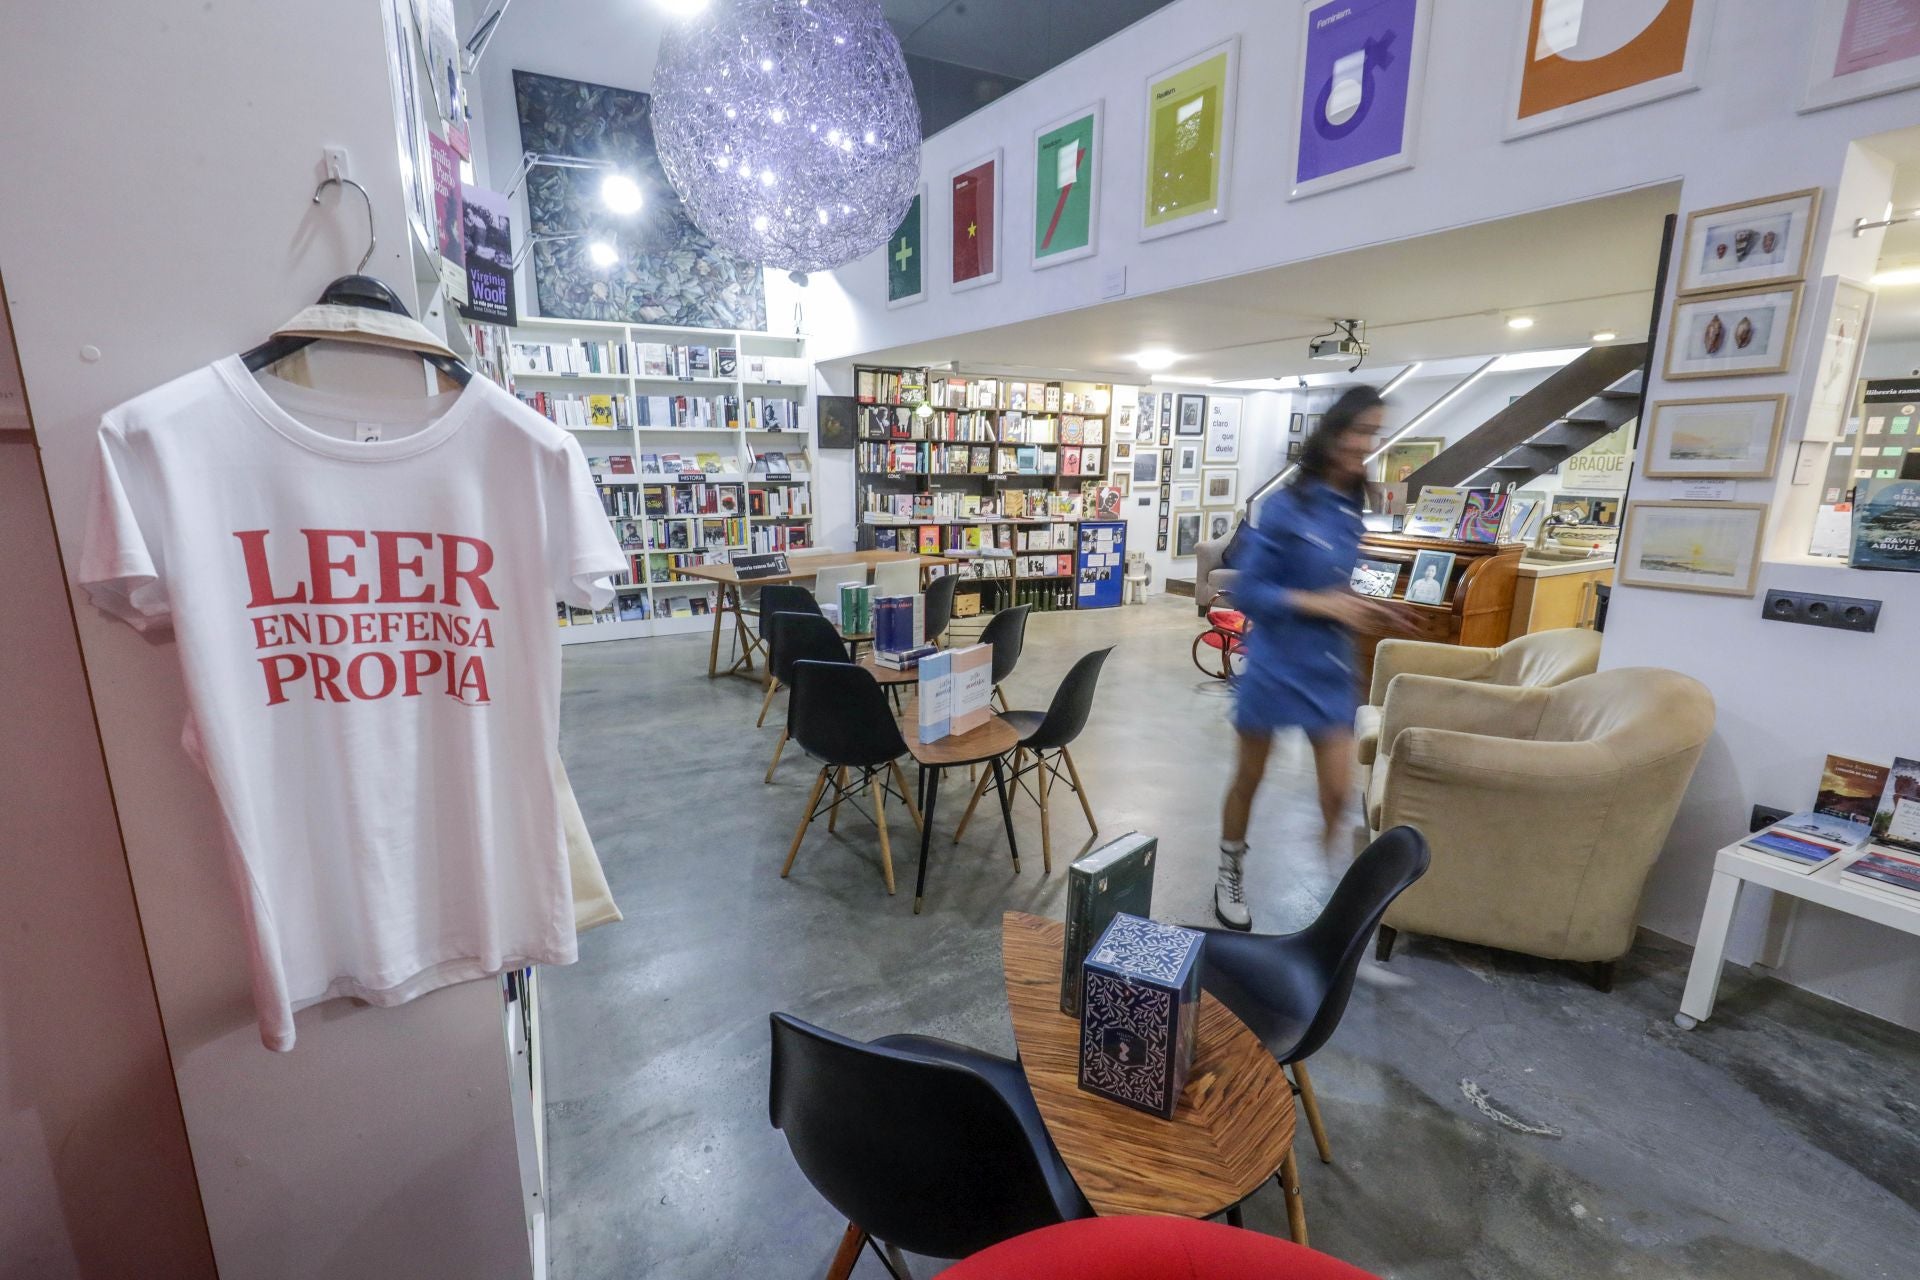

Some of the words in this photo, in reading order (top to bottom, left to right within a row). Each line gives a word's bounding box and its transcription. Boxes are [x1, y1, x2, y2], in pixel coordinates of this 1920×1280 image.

[470, 268, 506, 286] Virginia
[471, 280, 507, 305] Woolf
[1221, 433, 1234, 441] que
[1215, 443, 1234, 452] duele
[1569, 456, 1625, 472] BRAQUE
[1884, 537, 1917, 546] DAVID
[232, 528, 501, 611] LEER
[256, 649, 492, 707] PROPIA
